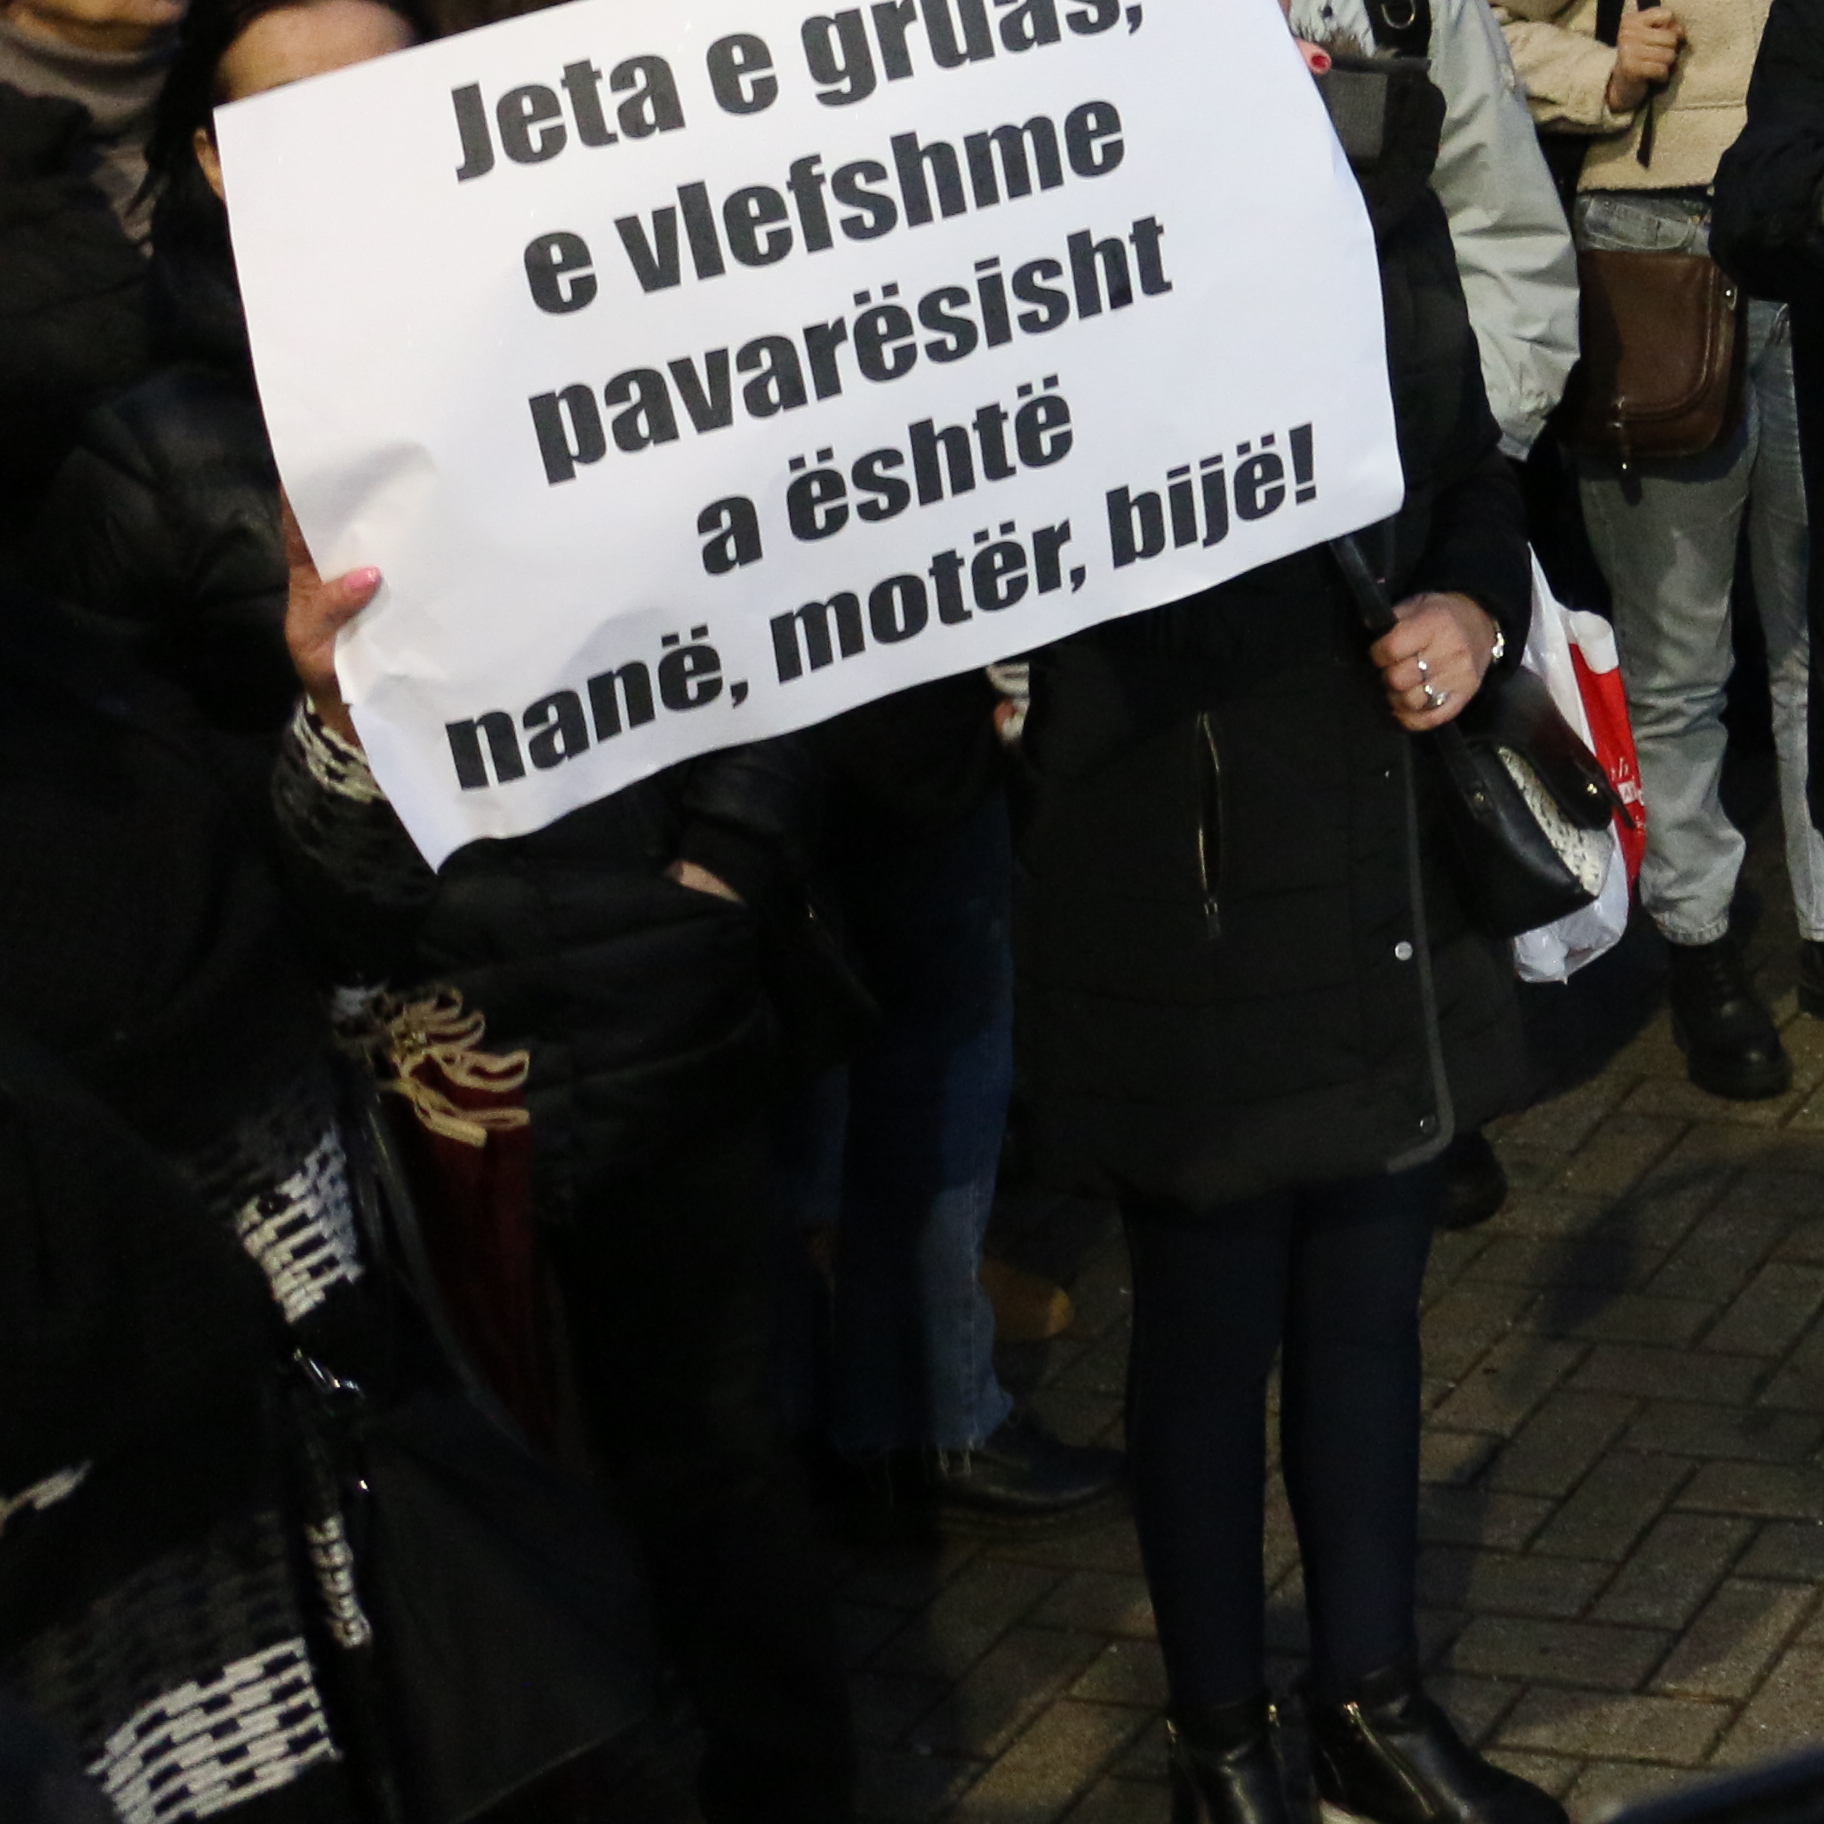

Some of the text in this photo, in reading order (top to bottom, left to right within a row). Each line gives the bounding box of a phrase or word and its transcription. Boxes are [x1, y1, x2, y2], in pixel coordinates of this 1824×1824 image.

[452, 56, 684, 180] Jeta
[707, 34, 777, 114] e
[525, 102, 1123, 313] e vlefshme
[529, 217, 1172, 484] pavarësisht
[697, 375, 1072, 575] a është
[445, 424, 1316, 790] nanë, motër, bijë!
